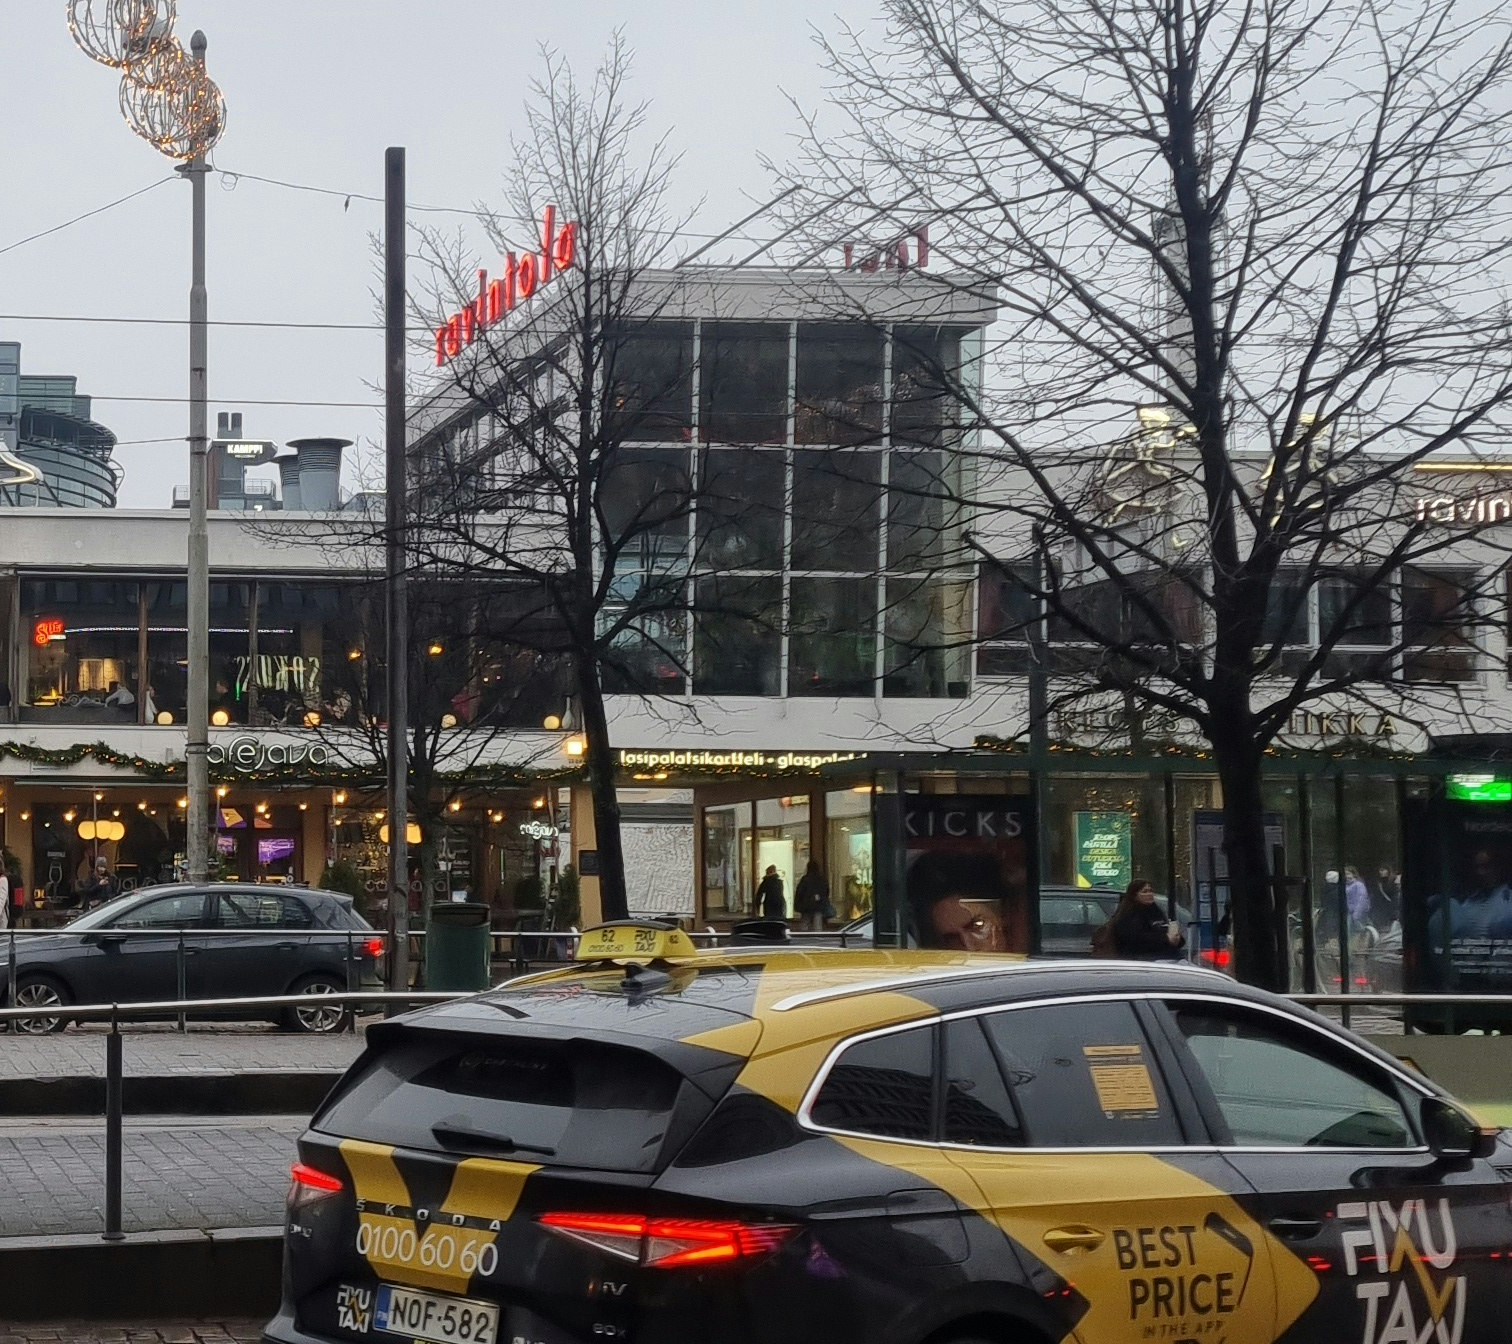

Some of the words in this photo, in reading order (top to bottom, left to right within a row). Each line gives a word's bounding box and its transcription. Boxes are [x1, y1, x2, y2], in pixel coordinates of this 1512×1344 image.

[436, 205, 580, 367] ravintola
[904, 811, 1022, 837] KICKS
[601, 930, 615, 943] 62
[356, 1222, 416, 1262] 0100
[420, 1233, 455, 1269] 60
[460, 1239, 499, 1277] 60
[1113, 1225, 1197, 1270] BEST
[1337, 1198, 1457, 1276] FIXU
[1129, 1272, 1235, 1320] PRICE
[338, 1307, 371, 1334] TAXI
[392, 1295, 489, 1344] NOF-582
[1143, 1326, 1155, 1339] IN
[1160, 1323, 1187, 1337] THE
[1195, 1320, 1223, 1334] APP
